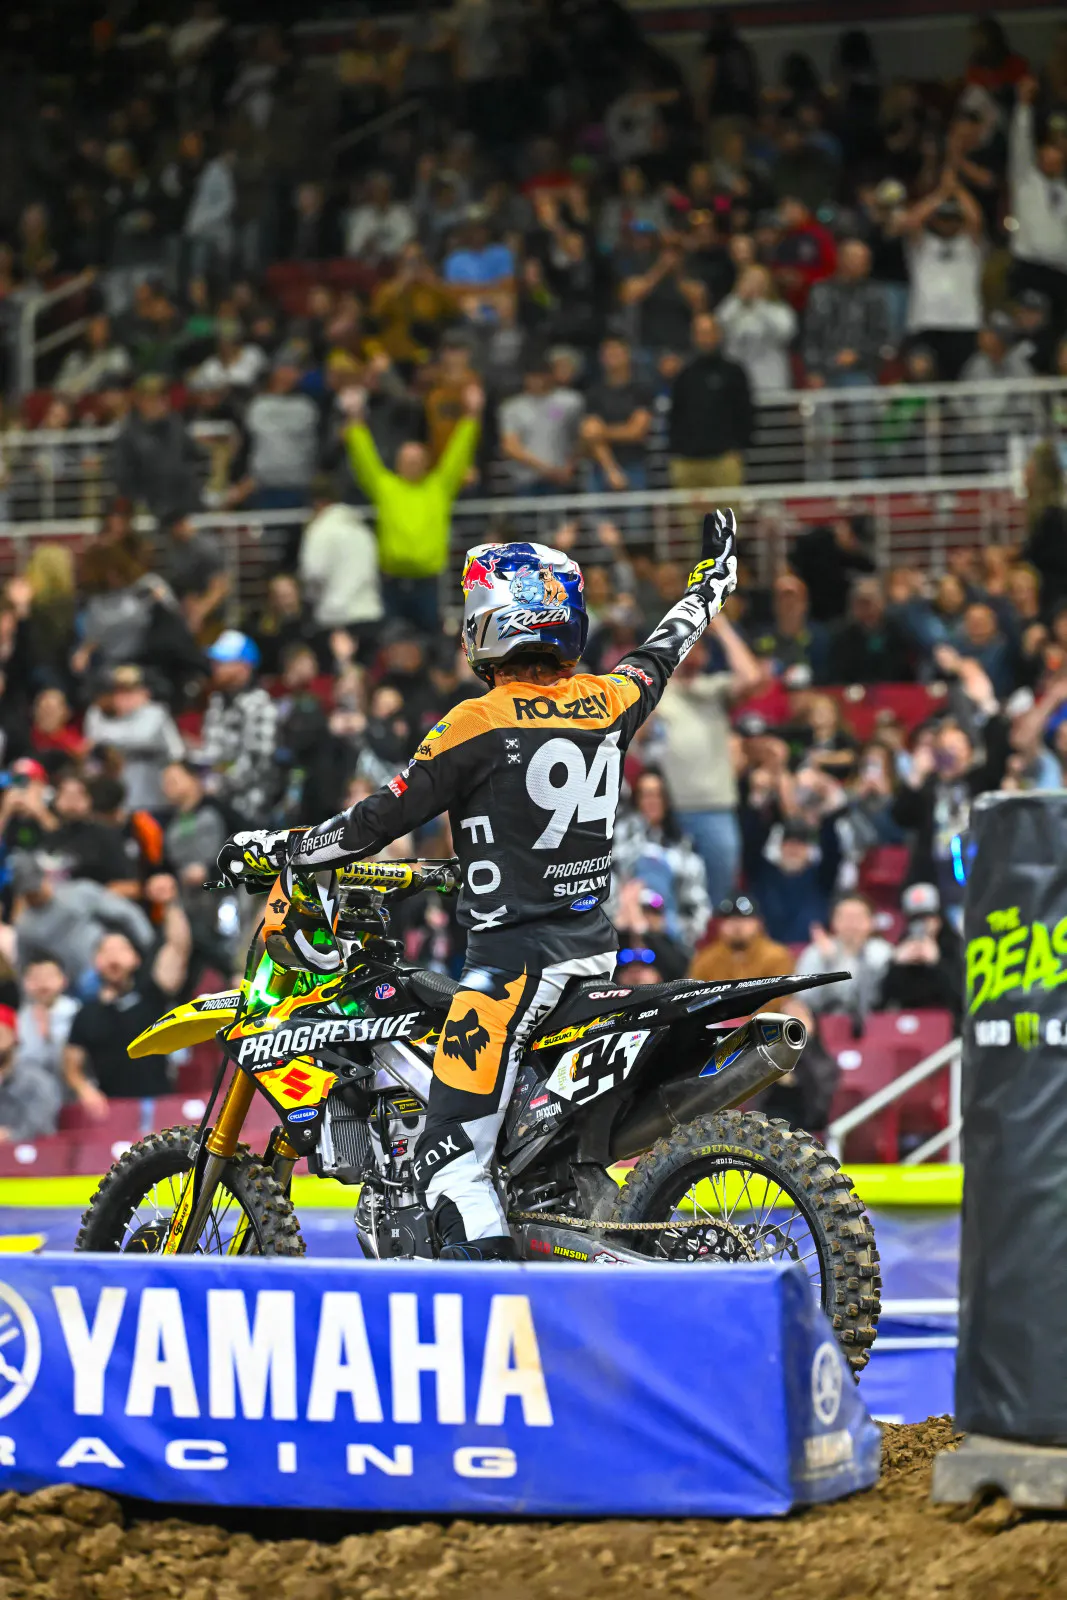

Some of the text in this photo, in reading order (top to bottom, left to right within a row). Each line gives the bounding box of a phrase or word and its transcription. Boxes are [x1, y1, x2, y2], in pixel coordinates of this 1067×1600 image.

[498, 607, 571, 638] ROCZEN
[525, 730, 622, 850] 94
[460, 815, 508, 931] FOX
[588, 988, 632, 1000] GUTS
[670, 983, 732, 1002] DUNLOP
[237, 1011, 421, 1065] PROGRESSIVE
[543, 1031, 572, 1047] SUZUKI
[569, 1031, 629, 1101] 94
[289, 1113, 303, 1121] CYCLE
[535, 1101, 562, 1119] DIXXON
[413, 1134, 461, 1182] FOX
[700, 1143, 766, 1162] DUNLOP
[553, 1245, 589, 1262] HINSON
[51, 1285, 554, 1427] YAMAHA
